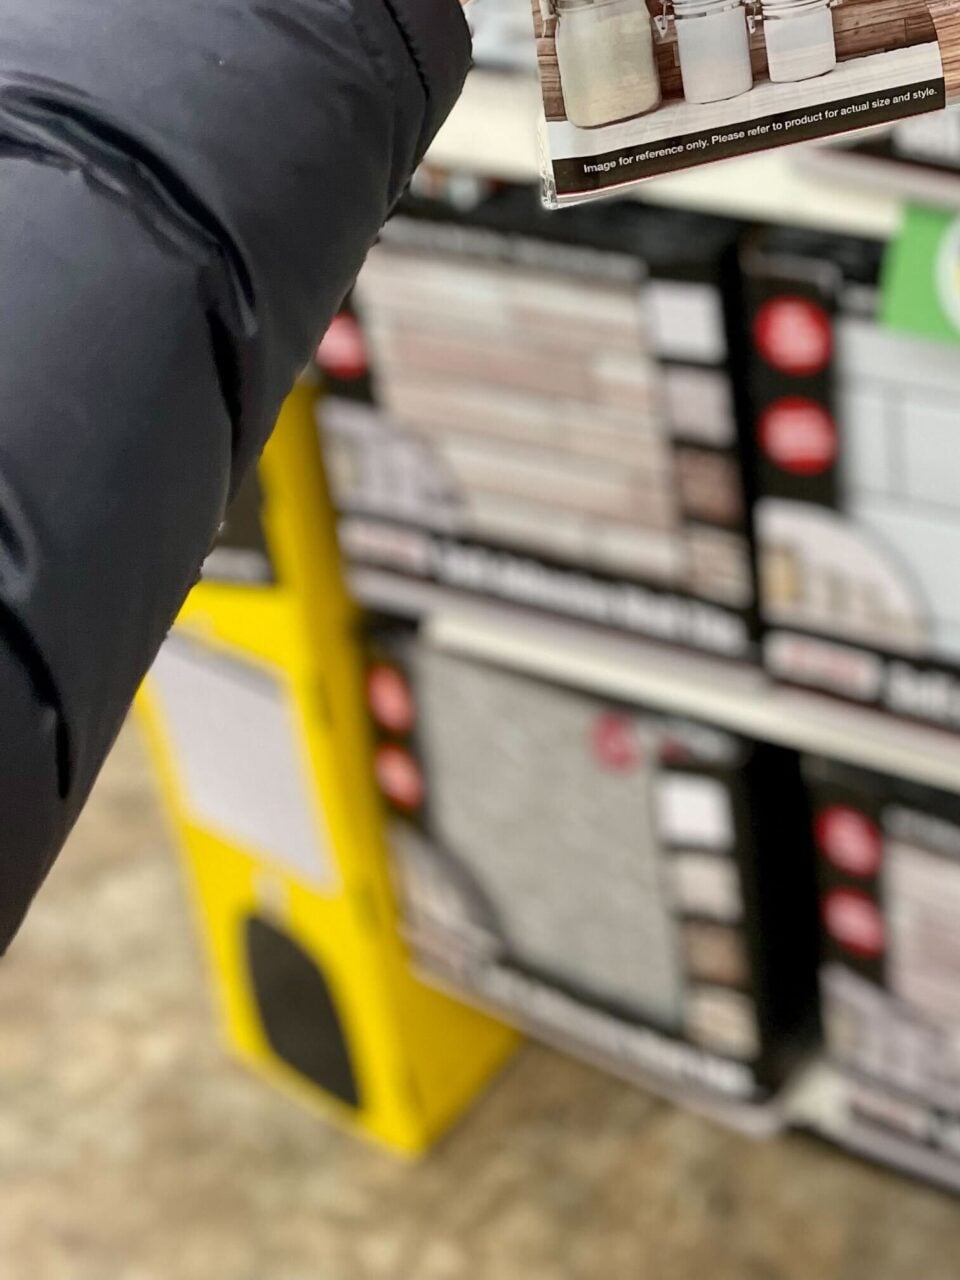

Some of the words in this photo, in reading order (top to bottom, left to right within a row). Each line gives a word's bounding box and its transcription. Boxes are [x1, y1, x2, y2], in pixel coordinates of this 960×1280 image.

[583, 160, 617, 174] Image
[618, 156, 633, 166] for
[635, 144, 684, 162] reference
[686, 138, 710, 151] only.
[711, 131, 745, 145] Please
[747, 123, 770, 137] refer
[772, 121, 783, 131] to
[784, 112, 823, 131] product
[825, 108, 839, 119] for
[840, 102, 870, 116] actual
[871, 97, 891, 108] size
[892, 91, 911, 104] and
[912, 87, 938, 100] style.
